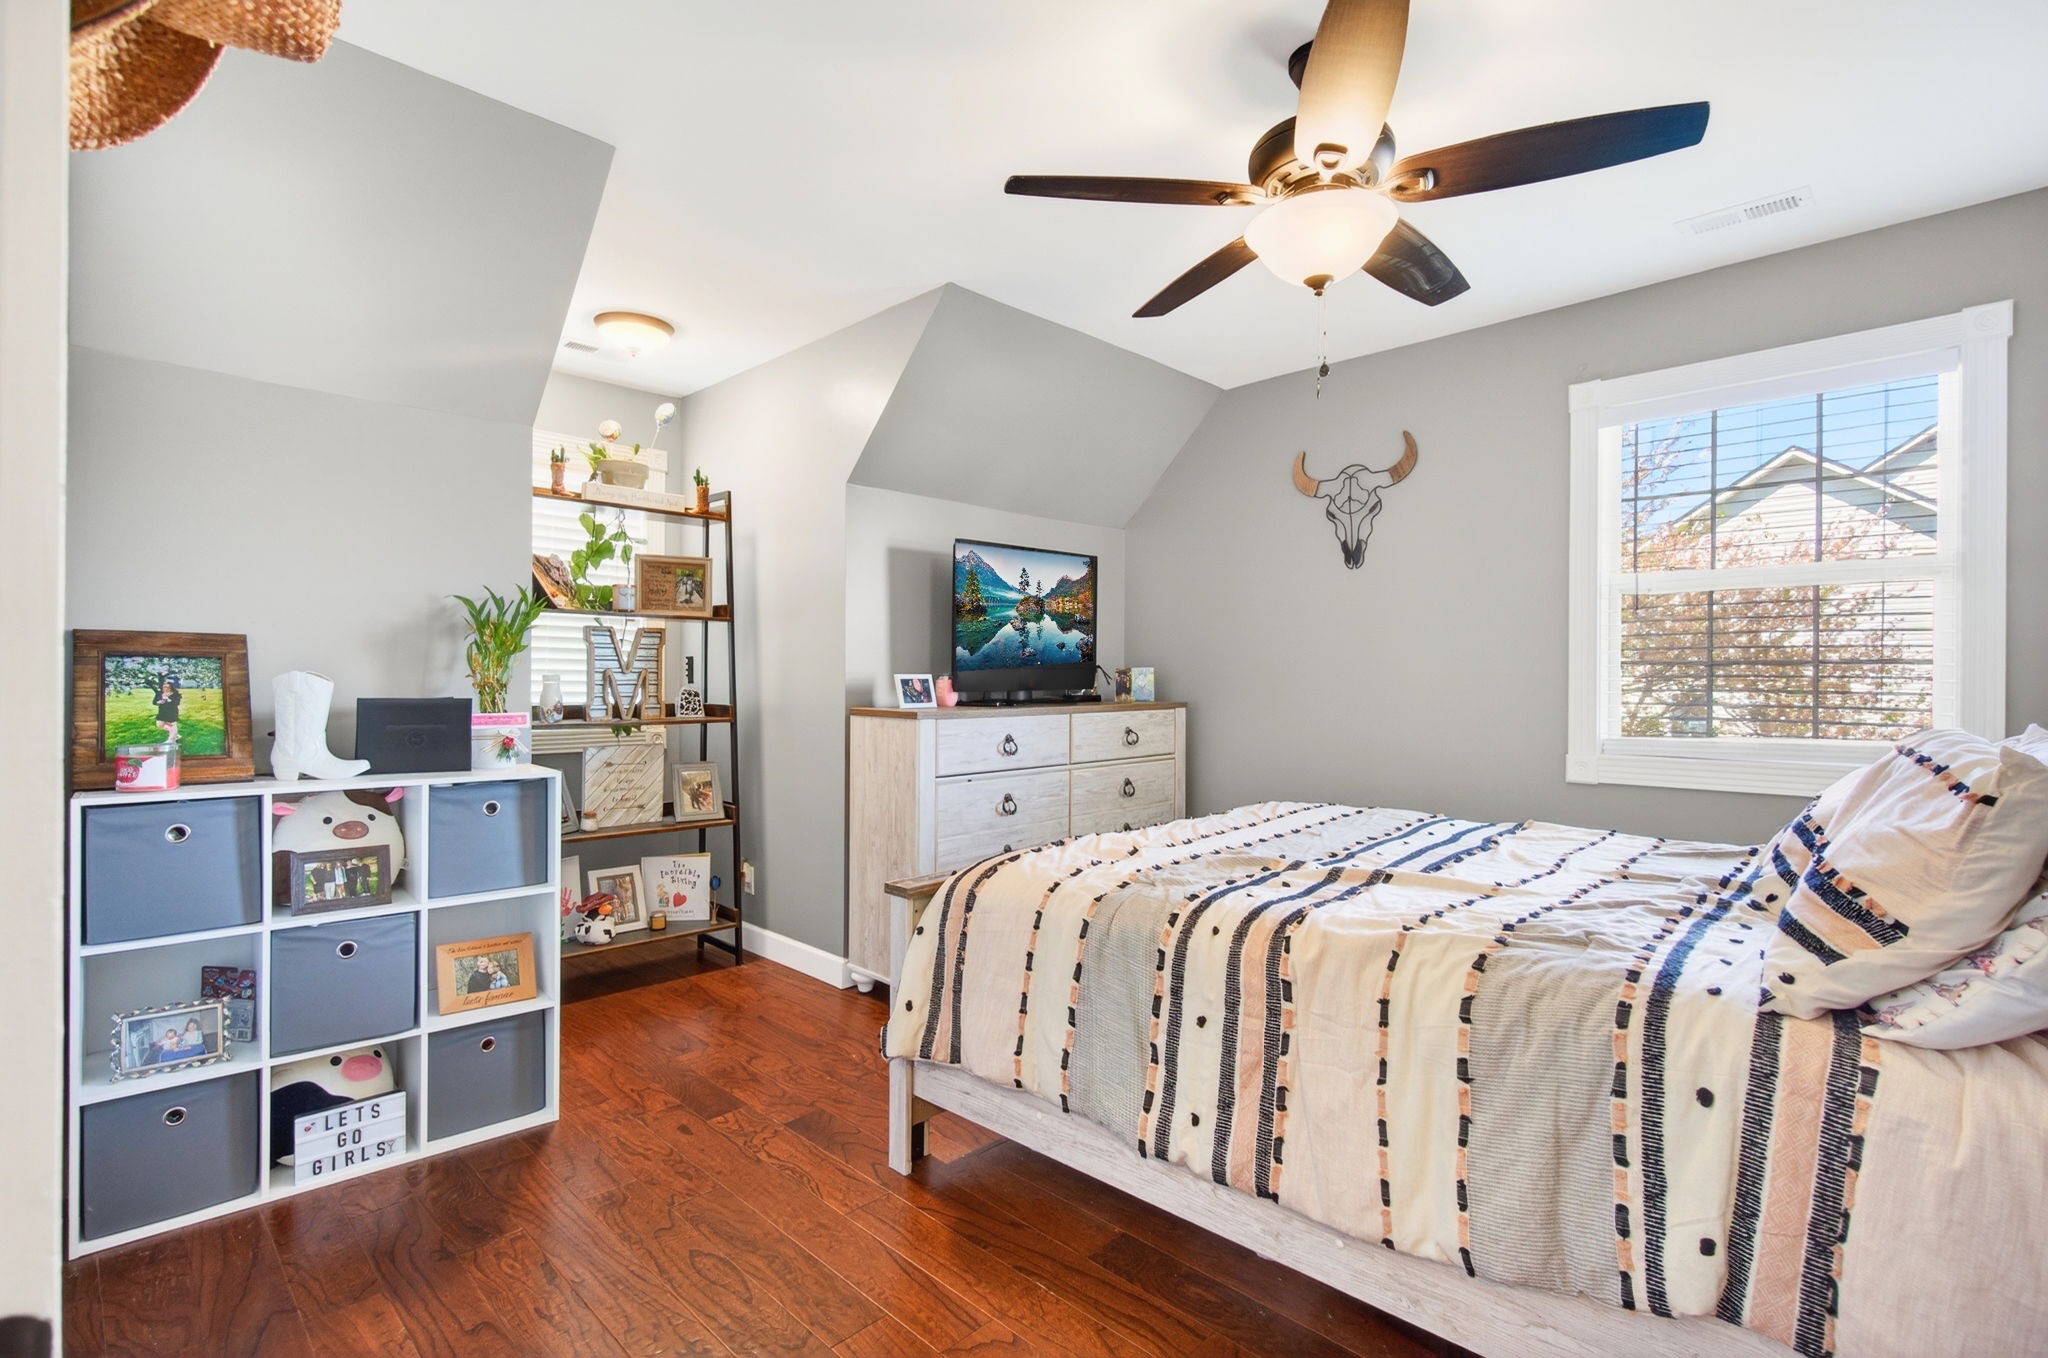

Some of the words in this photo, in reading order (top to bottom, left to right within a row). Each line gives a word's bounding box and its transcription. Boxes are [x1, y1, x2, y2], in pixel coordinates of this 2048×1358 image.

[325, 1103, 381, 1131] LETS
[337, 1128, 362, 1148] GO
[312, 1141, 386, 1176] GIRLS
